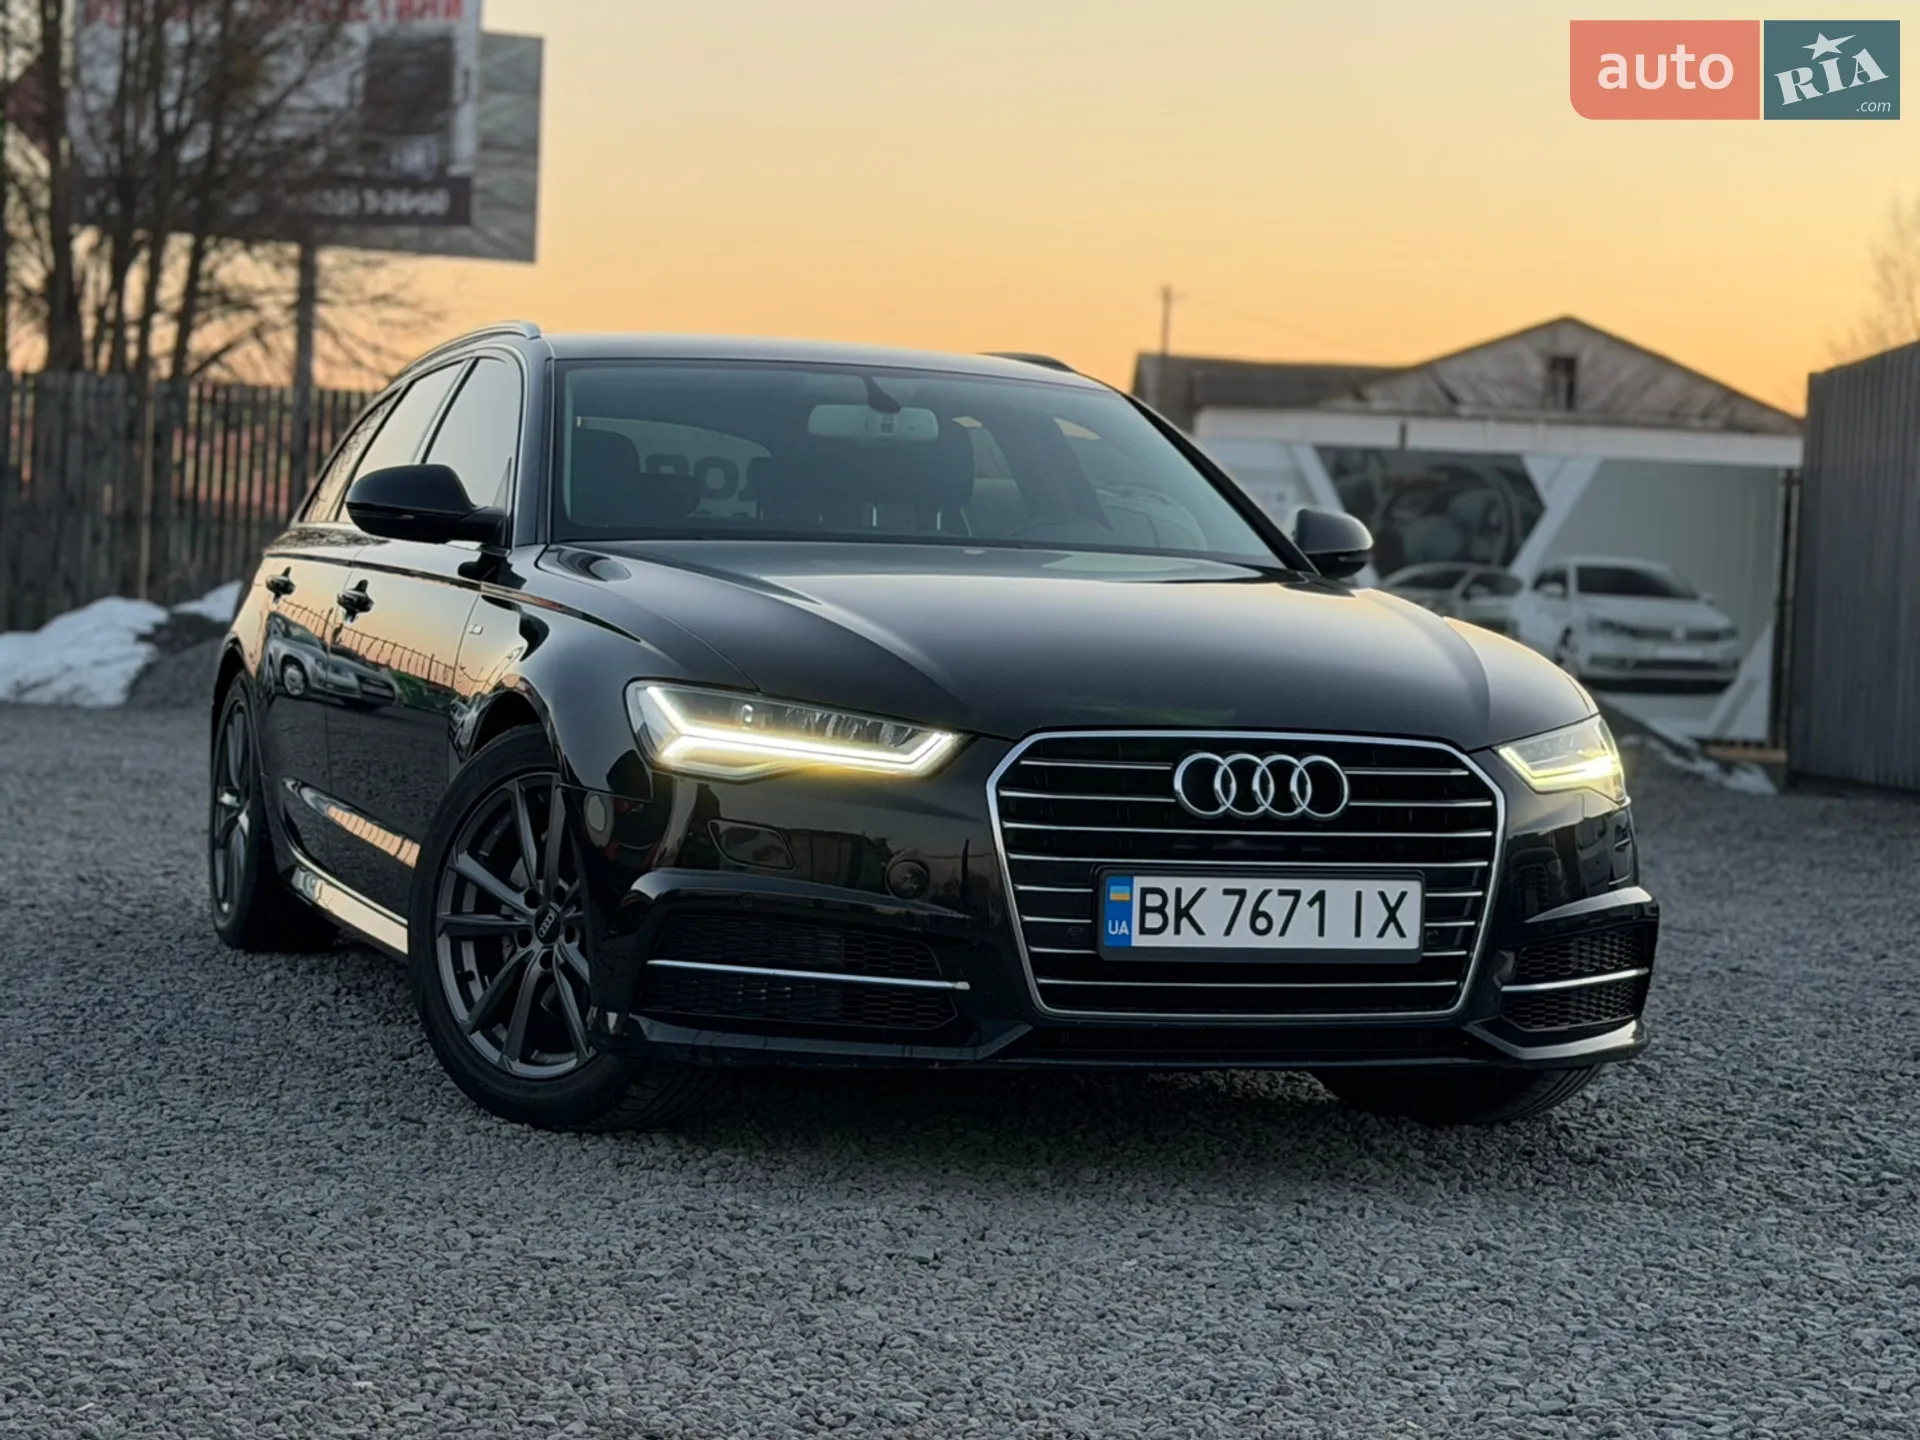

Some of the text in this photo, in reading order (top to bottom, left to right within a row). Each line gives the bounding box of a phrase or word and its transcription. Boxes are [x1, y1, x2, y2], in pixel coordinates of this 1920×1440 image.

[1107, 919, 1130, 936] UA
[1138, 886, 1409, 939] BK 7671 IX
